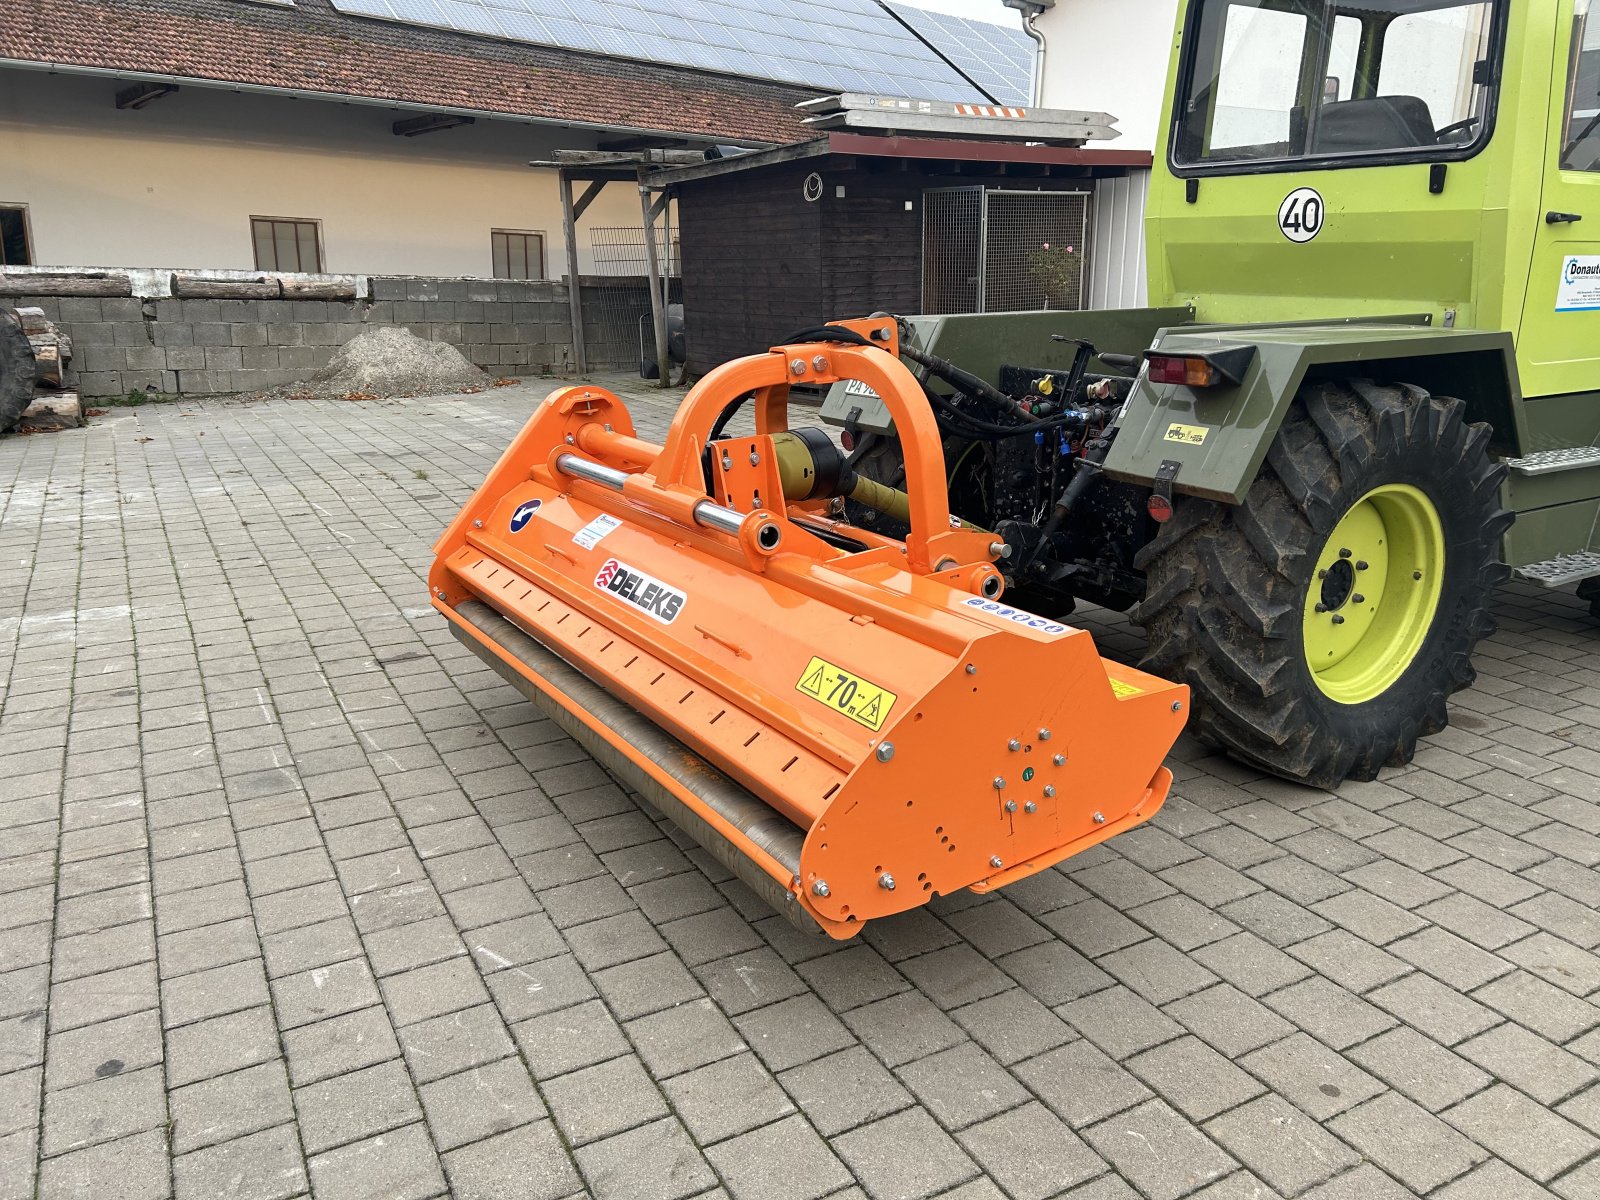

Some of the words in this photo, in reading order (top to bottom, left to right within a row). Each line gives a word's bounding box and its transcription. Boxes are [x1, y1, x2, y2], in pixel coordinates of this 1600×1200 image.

[1282, 197, 1320, 233] 40
[608, 567, 684, 622] DELEKS
[826, 673, 858, 708] 70
[847, 705, 856, 715] m
